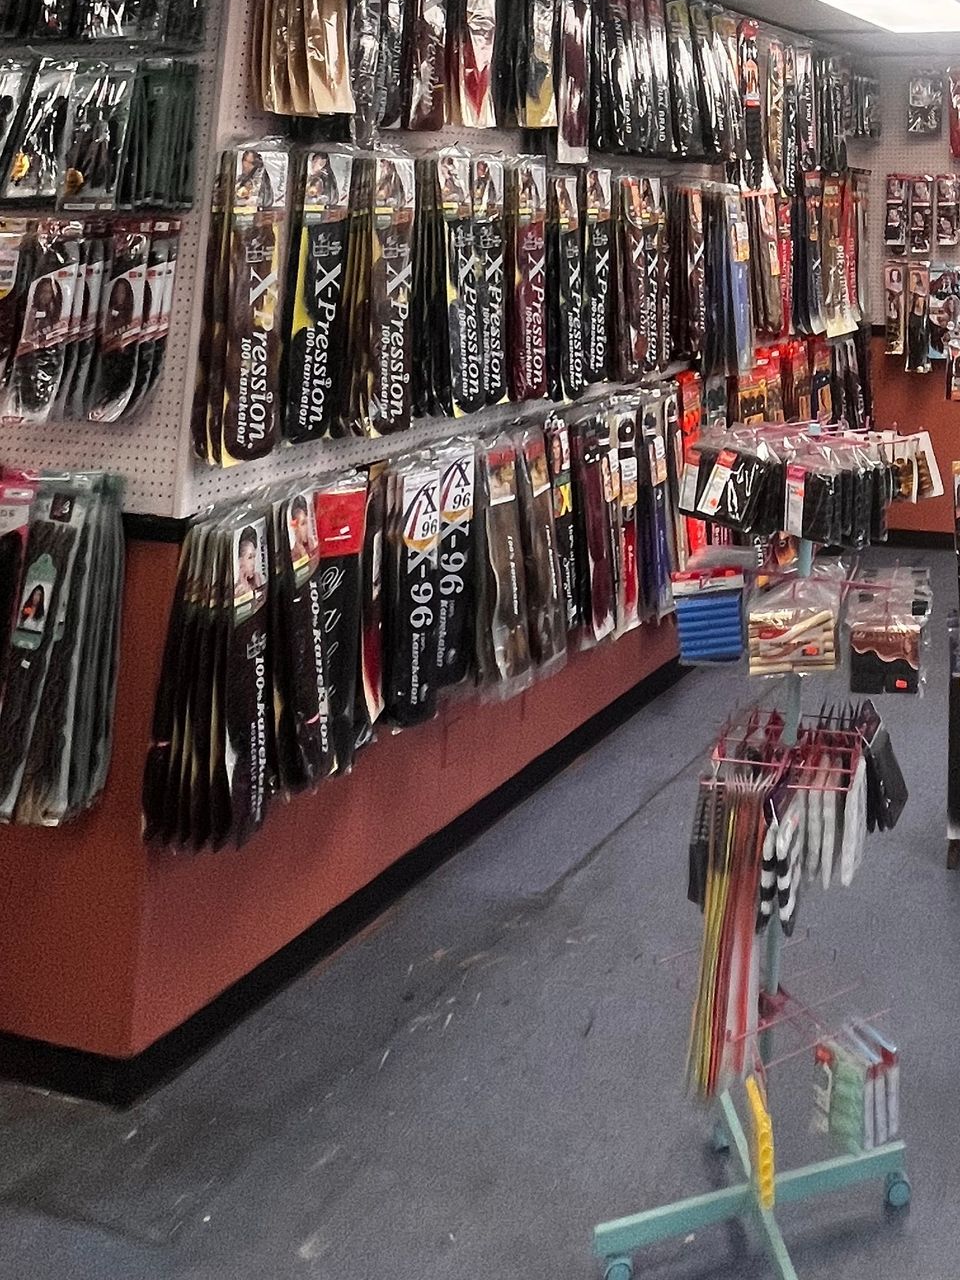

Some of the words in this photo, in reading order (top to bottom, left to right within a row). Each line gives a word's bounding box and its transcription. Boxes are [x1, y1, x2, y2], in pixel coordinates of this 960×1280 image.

[407, 545, 437, 629] X-96
[439, 517, 470, 596] X-96
[410, 632, 421, 705] Kanekalon
[436, 600, 449, 668] Kanekalon
